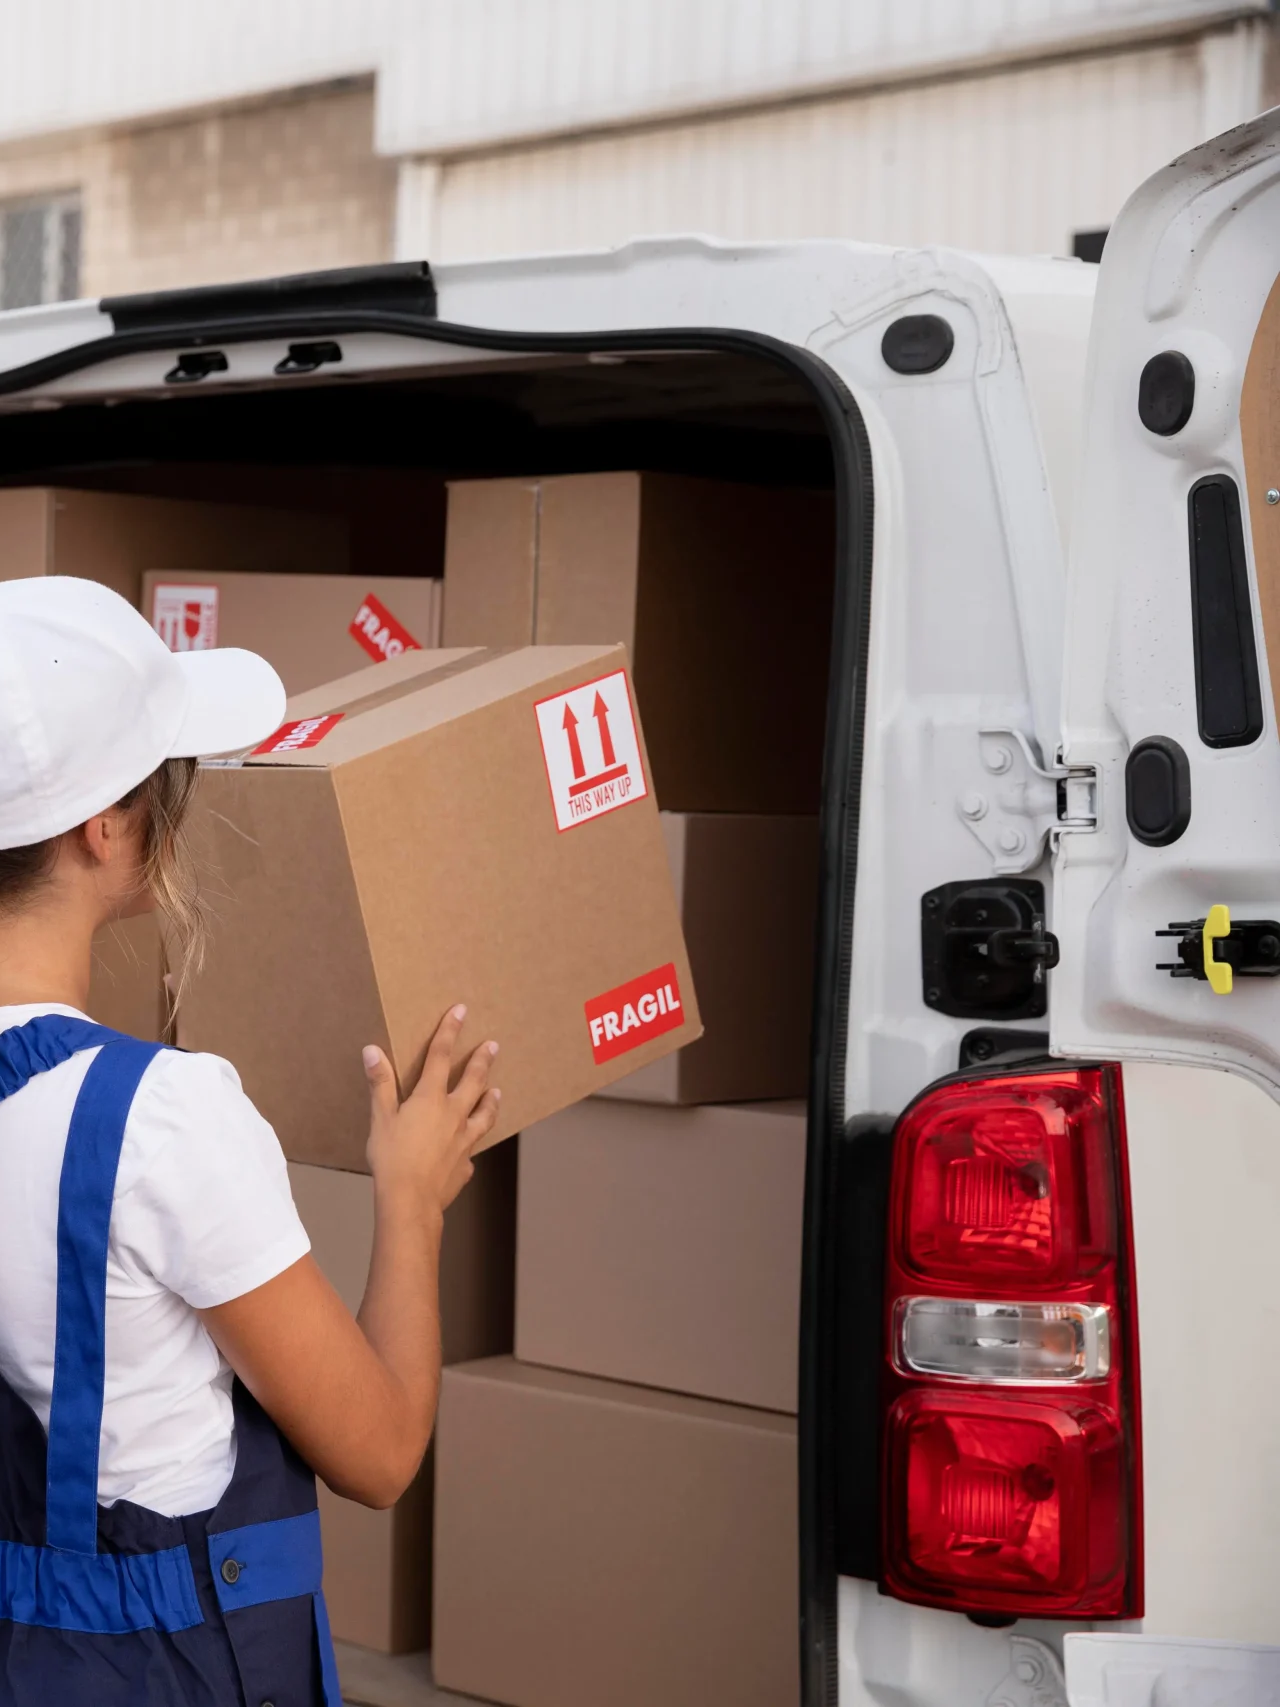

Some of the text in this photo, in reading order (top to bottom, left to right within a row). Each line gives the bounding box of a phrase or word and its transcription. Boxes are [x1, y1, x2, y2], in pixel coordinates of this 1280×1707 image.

[354, 604, 414, 660] FRAG
[270, 715, 329, 753] FRAGIL
[568, 776, 631, 818] THIS WAY UP
[589, 984, 680, 1047] FRAGIL
